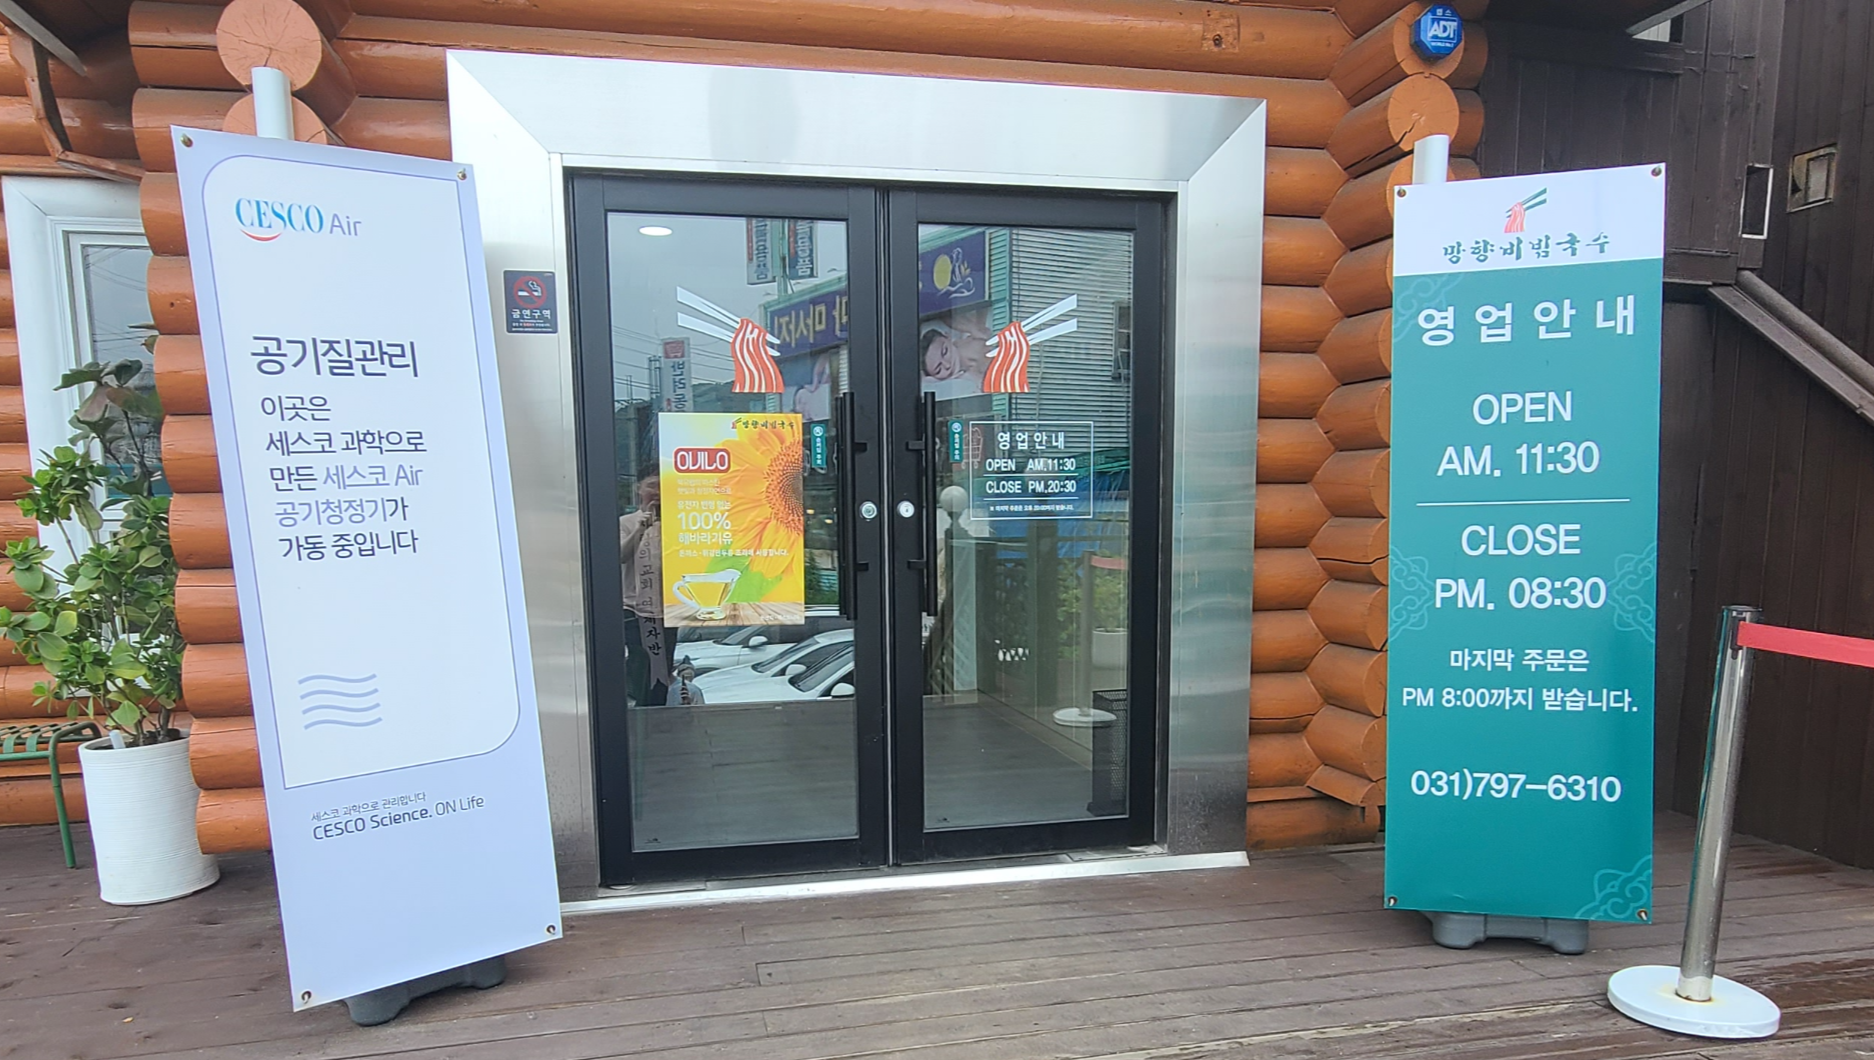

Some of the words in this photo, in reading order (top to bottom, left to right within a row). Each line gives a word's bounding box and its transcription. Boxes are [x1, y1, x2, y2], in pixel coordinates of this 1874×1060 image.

[1428, 20, 1458, 38] ADT
[235, 198, 324, 234] CESCO
[329, 213, 362, 236] Air
[1443, 231, 1611, 265] 망향비빔국수
[511, 308, 551, 320] 금연구역
[250, 335, 419, 377] 공기질관리
[261, 395, 331, 421] 이곳은
[1472, 390, 1572, 425] OPEN
[266, 431, 337, 456] 세스코
[340, 429, 427, 455] 과학으로
[997, 432, 1065, 450] 영업안내
[985, 458, 1016, 471] OPEN
[1436, 444, 1501, 477] AM.
[1516, 440, 1600, 474] 11:30
[269, 466, 317, 492] 만든
[322, 464, 390, 490] 세스코
[394, 464, 423, 486] Air
[985, 481, 1022, 494] CLOSE
[274, 496, 409, 528] 공기청정기가
[677, 511, 731, 530] 100%
[278, 534, 327, 561] 가동
[331, 529, 419, 559] 중입니다
[678, 531, 733, 545] 해바라기유
[1461, 523, 1582, 556] CLOSE
[1434, 578, 1495, 610] PM.
[1508, 576, 1607, 609] 08:30
[1450, 648, 1515, 671] 마지막
[1522, 648, 1590, 672] 주문은
[1402, 687, 1434, 706] PM
[1441, 687, 1534, 711] 8:00까지
[1542, 687, 1638, 712] 받습니다.
[1410, 768, 1622, 803] 031)797-6310
[311, 808, 341, 822] 세스코
[342, 801, 380, 817] 과학으로
[312, 817, 366, 840] CESCO
[370, 808, 433, 829] Science.
[435, 800, 457, 817] ON
[459, 795, 485, 812] Life
